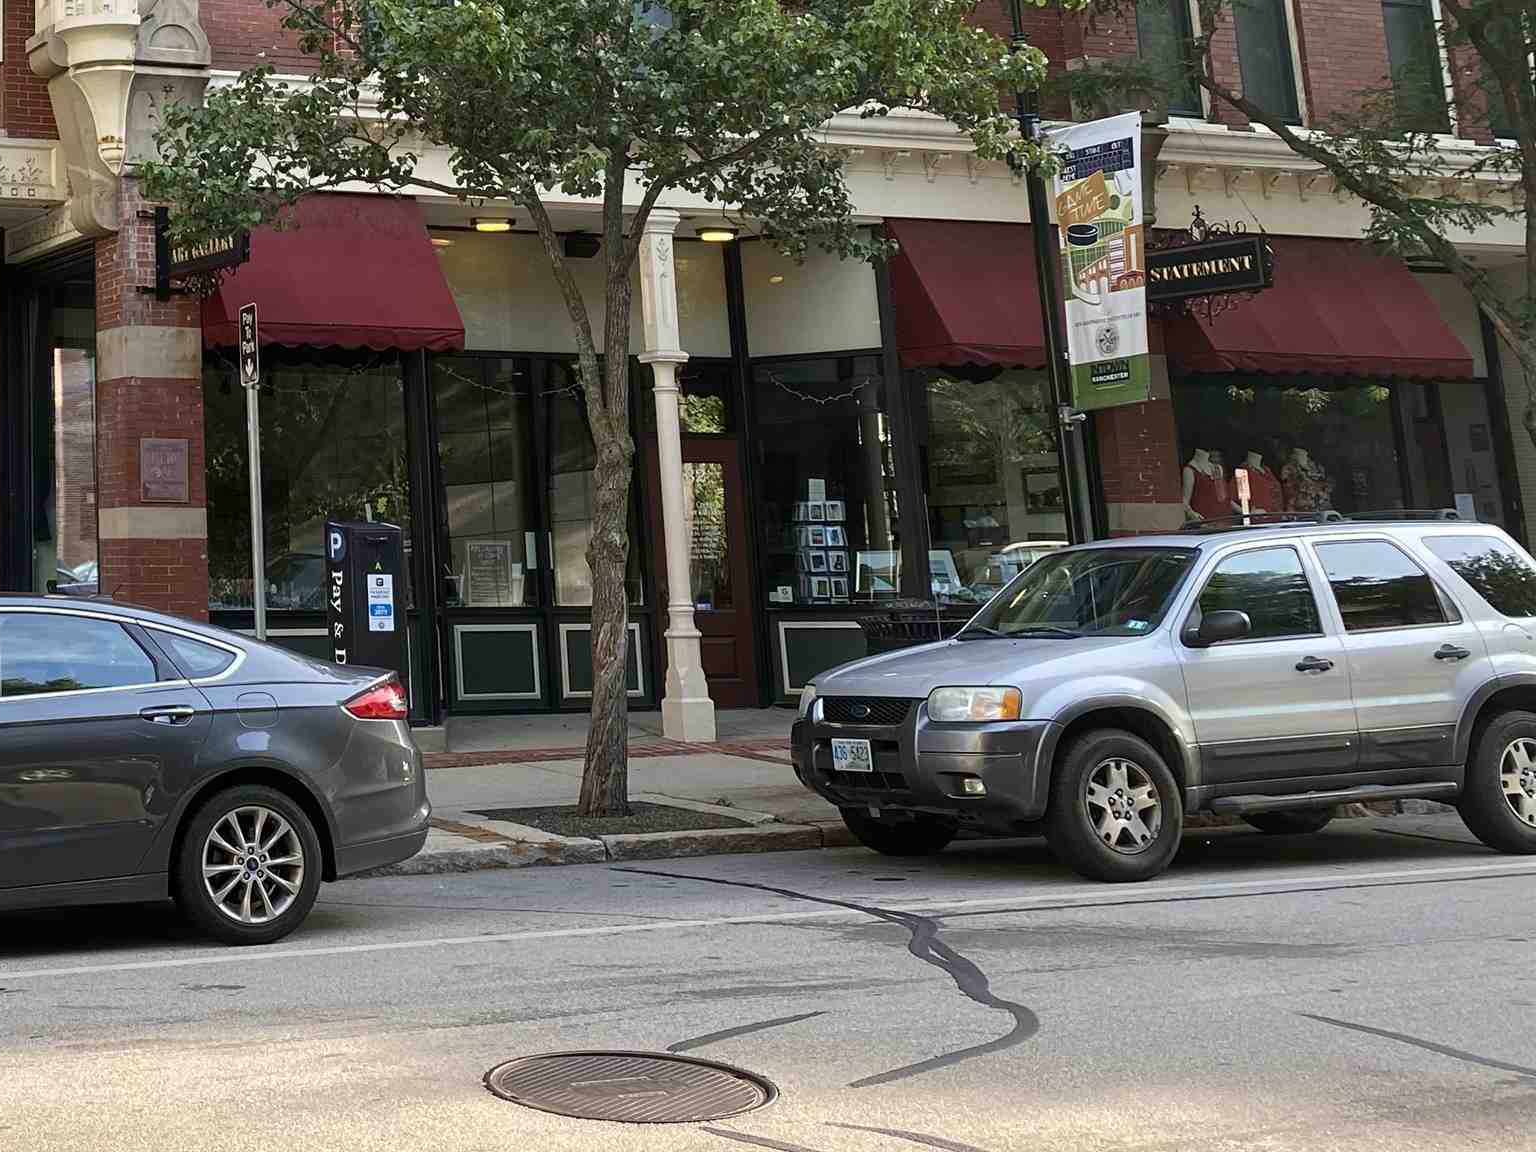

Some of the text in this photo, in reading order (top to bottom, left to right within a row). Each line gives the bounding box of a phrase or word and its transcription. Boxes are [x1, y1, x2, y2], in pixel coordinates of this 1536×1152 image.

[1150, 255, 1253, 282] STATEMENT
[330, 532, 342, 559] P
[331, 570, 343, 613] Pay
[334, 621, 344, 639] &
